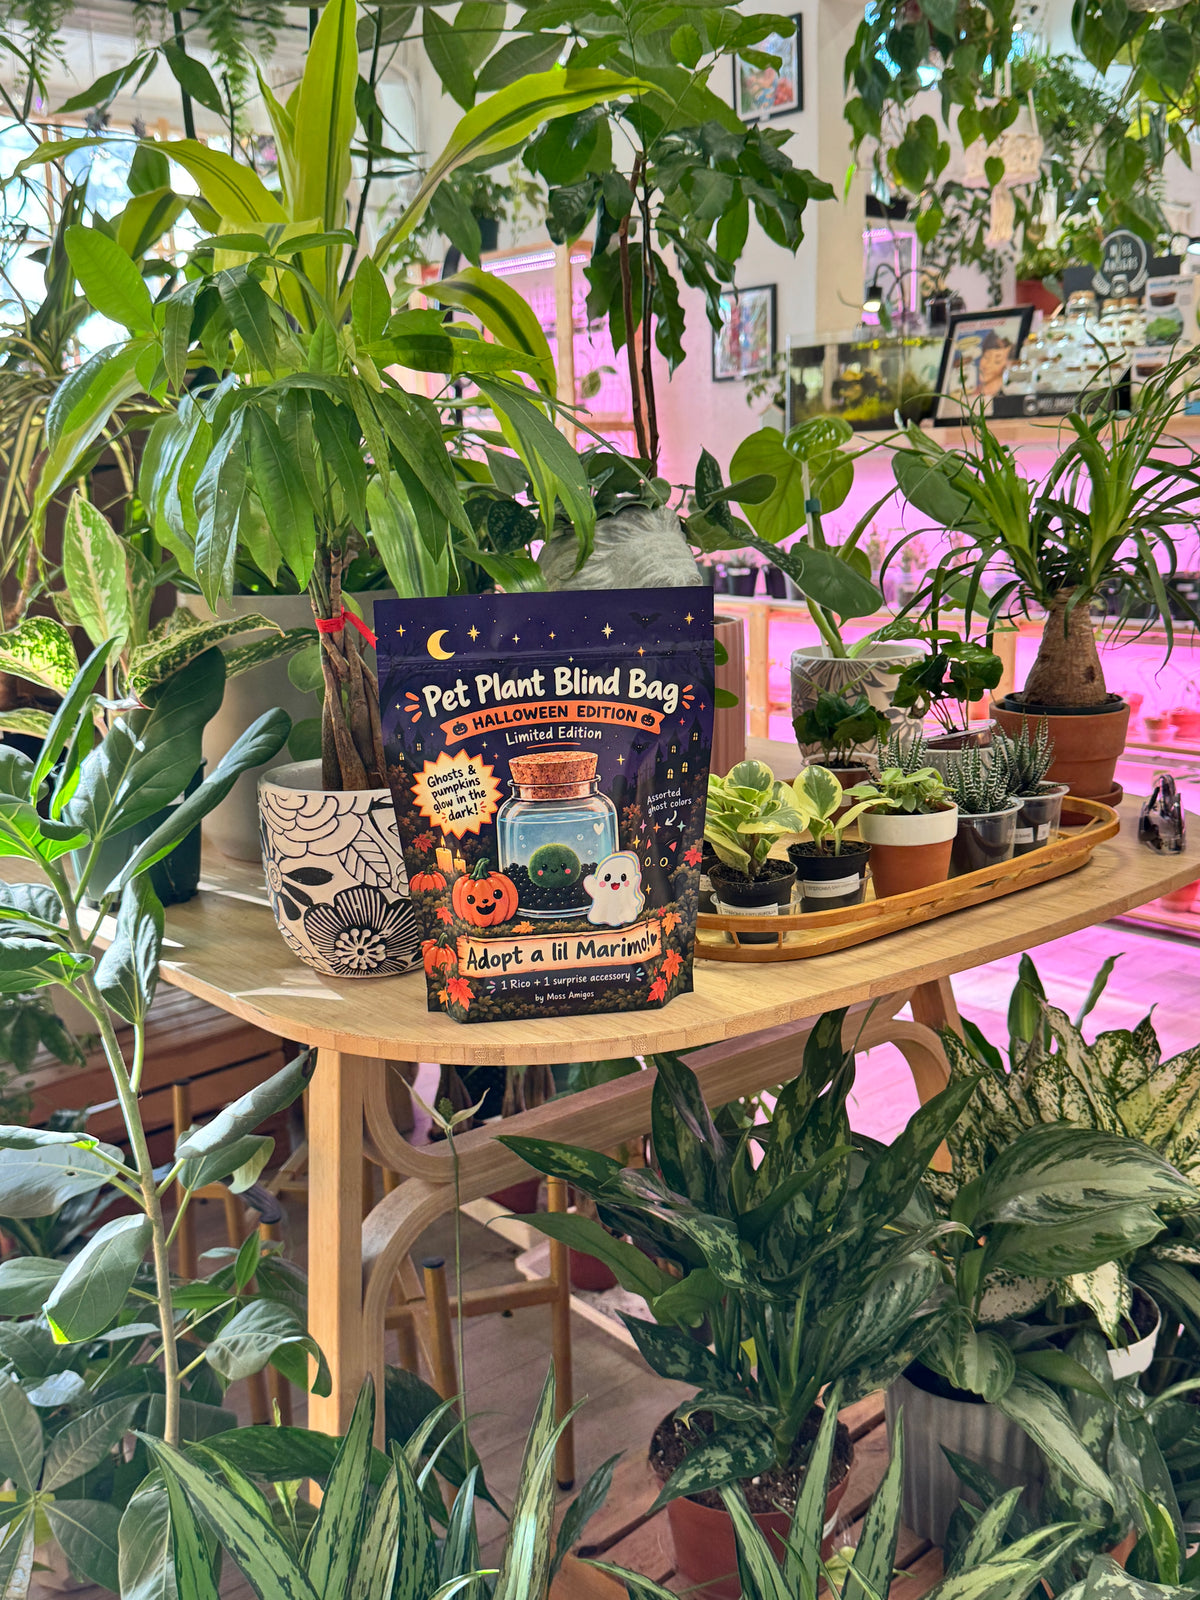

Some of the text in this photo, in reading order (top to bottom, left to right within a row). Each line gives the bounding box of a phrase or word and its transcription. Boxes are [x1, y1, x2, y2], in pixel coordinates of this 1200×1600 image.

[422, 666, 679, 718] Pet Plant Blind Bag
[472, 705, 638, 731] HALLOWEEN EDITION
[505, 726, 602, 746] Limited Edition
[427, 764, 477, 788] Ghosts &
[431, 777, 481, 801] pumpkins
[647, 787, 681, 805] Assorted
[433, 789, 487, 814] glow in the
[448, 803, 479, 821] dark!
[648, 798, 692, 818] ghost colors
[467, 931, 651, 971] Adopt a lil Marimo!
[501, 980, 508, 991] 1
[510, 979, 531, 989] Rico
[544, 976, 550, 986] 1
[553, 974, 589, 988] surprise
[590, 972, 631, 984] accessory
[535, 990, 595, 1004] by Moss Amigos
